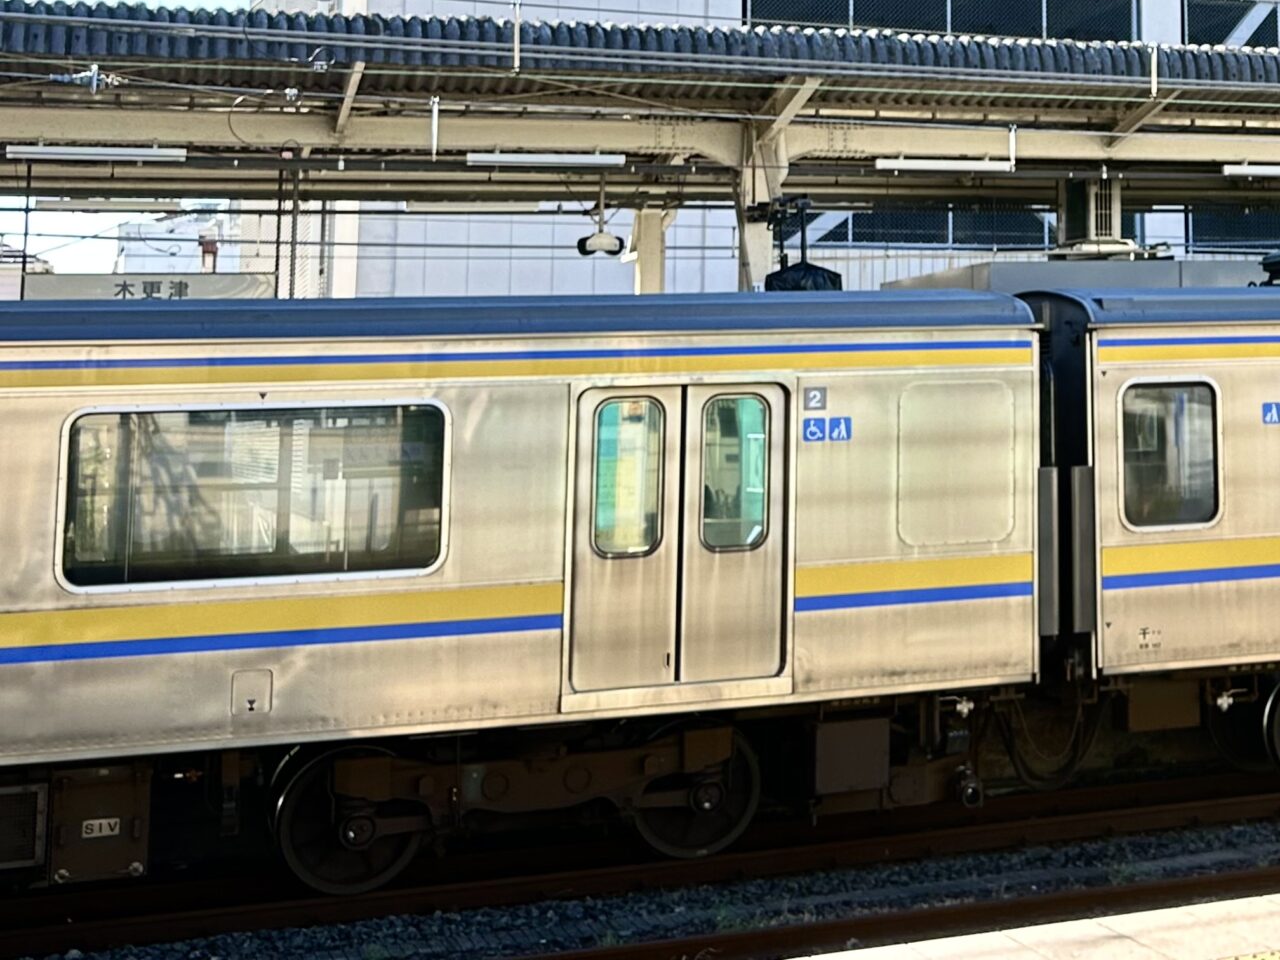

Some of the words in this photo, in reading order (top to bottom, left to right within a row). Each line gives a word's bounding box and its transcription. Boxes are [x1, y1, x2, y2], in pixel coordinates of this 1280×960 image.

[114, 280, 189, 300] 木更津
[809, 390, 822, 408] 2
[84, 821, 118, 835] SIV
